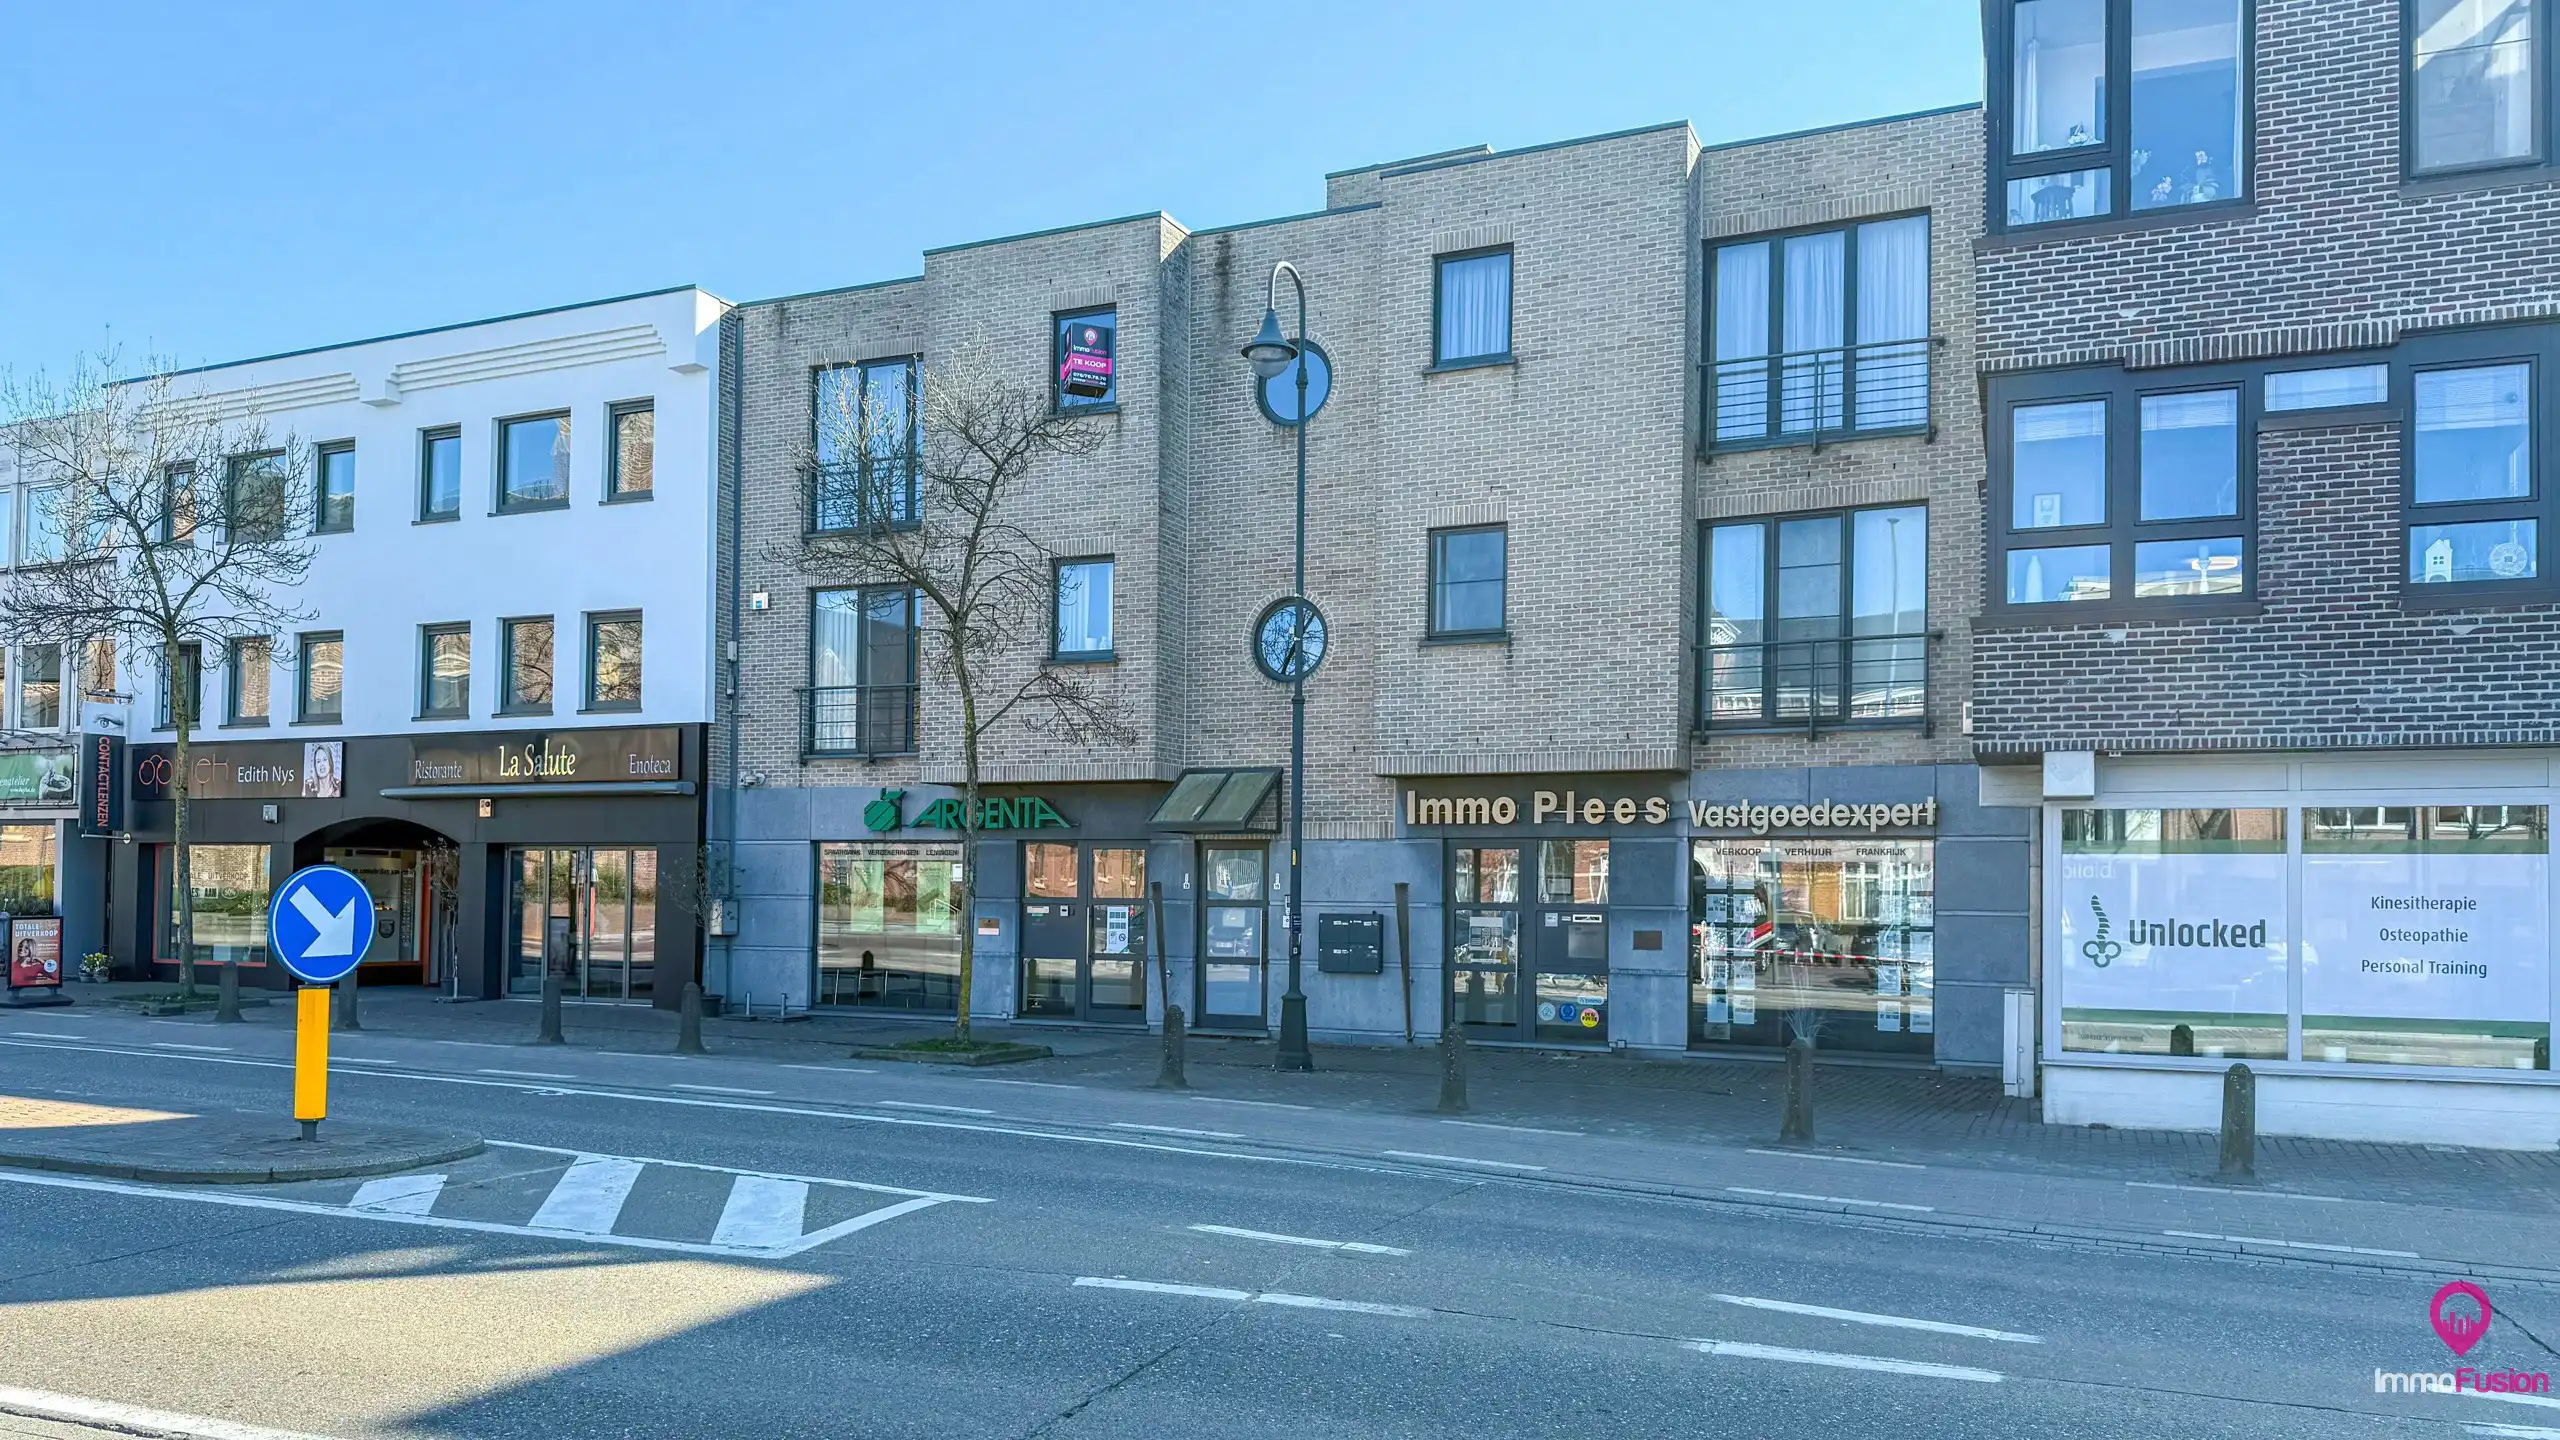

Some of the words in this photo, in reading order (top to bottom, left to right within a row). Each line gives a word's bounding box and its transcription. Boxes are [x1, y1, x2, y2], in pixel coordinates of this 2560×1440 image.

[1073, 358, 1082, 366] TE
[1085, 359, 1107, 368] KOOP
[499, 745, 520, 777] La
[524, 738, 576, 777] Salute
[629, 753, 672, 775] Enoteca
[237, 766, 269, 783] Edith
[272, 765, 295, 787] Nys
[415, 759, 462, 779] Ristorante
[97, 736, 111, 827] CONTACTLENZEN
[908, 797, 1071, 829] ARGENTA
[1406, 790, 1517, 825] Immo
[1533, 790, 1668, 825] Plees
[1688, 796, 1936, 835] Vastgoedexpert
[1715, 847, 1762, 857] VERKOOP
[1784, 847, 1832, 857] VERHUUR
[1856, 847, 1906, 857] FRANKRIJK
[204, 887, 217, 898] AAN
[2371, 895, 2477, 914] Kinesitherapie
[2129, 918, 2266, 949] Unlocked
[2379, 927, 2468, 945] Osteopathie
[2361, 958, 2424, 975] Personal
[2428, 959, 2487, 978] Training
